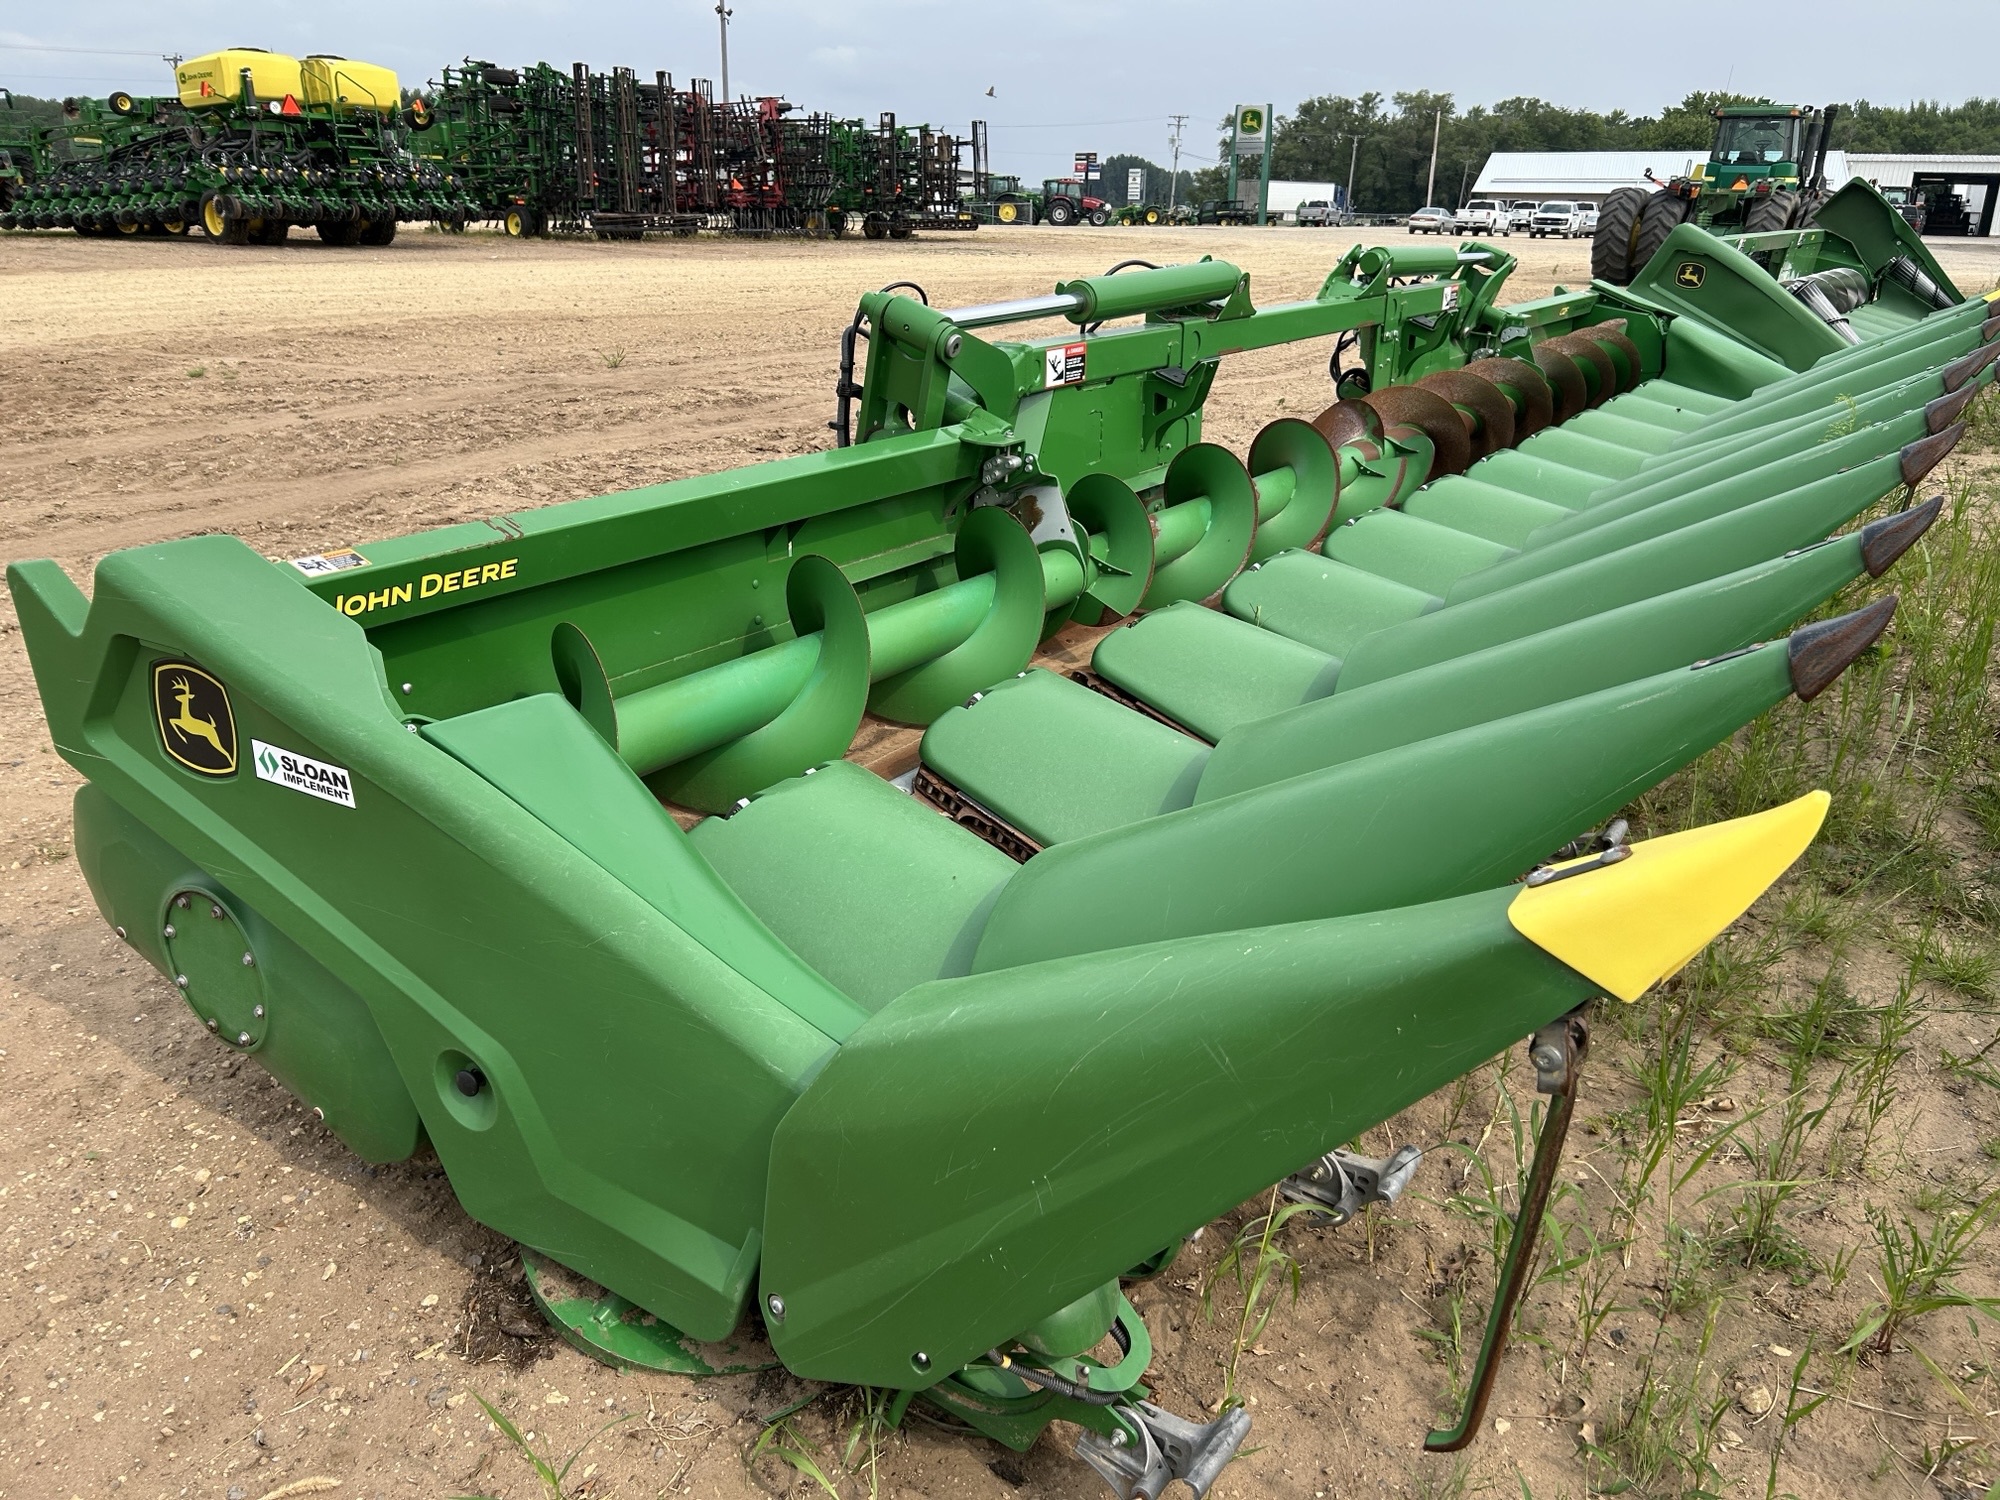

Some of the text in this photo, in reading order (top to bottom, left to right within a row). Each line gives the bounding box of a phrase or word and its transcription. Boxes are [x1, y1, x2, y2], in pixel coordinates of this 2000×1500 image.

[197, 71, 213, 79] DEERE
[419, 558, 519, 600] DEERE
[280, 755, 349, 790] SLOAN
[283, 772, 350, 801] IMPLEMENT
